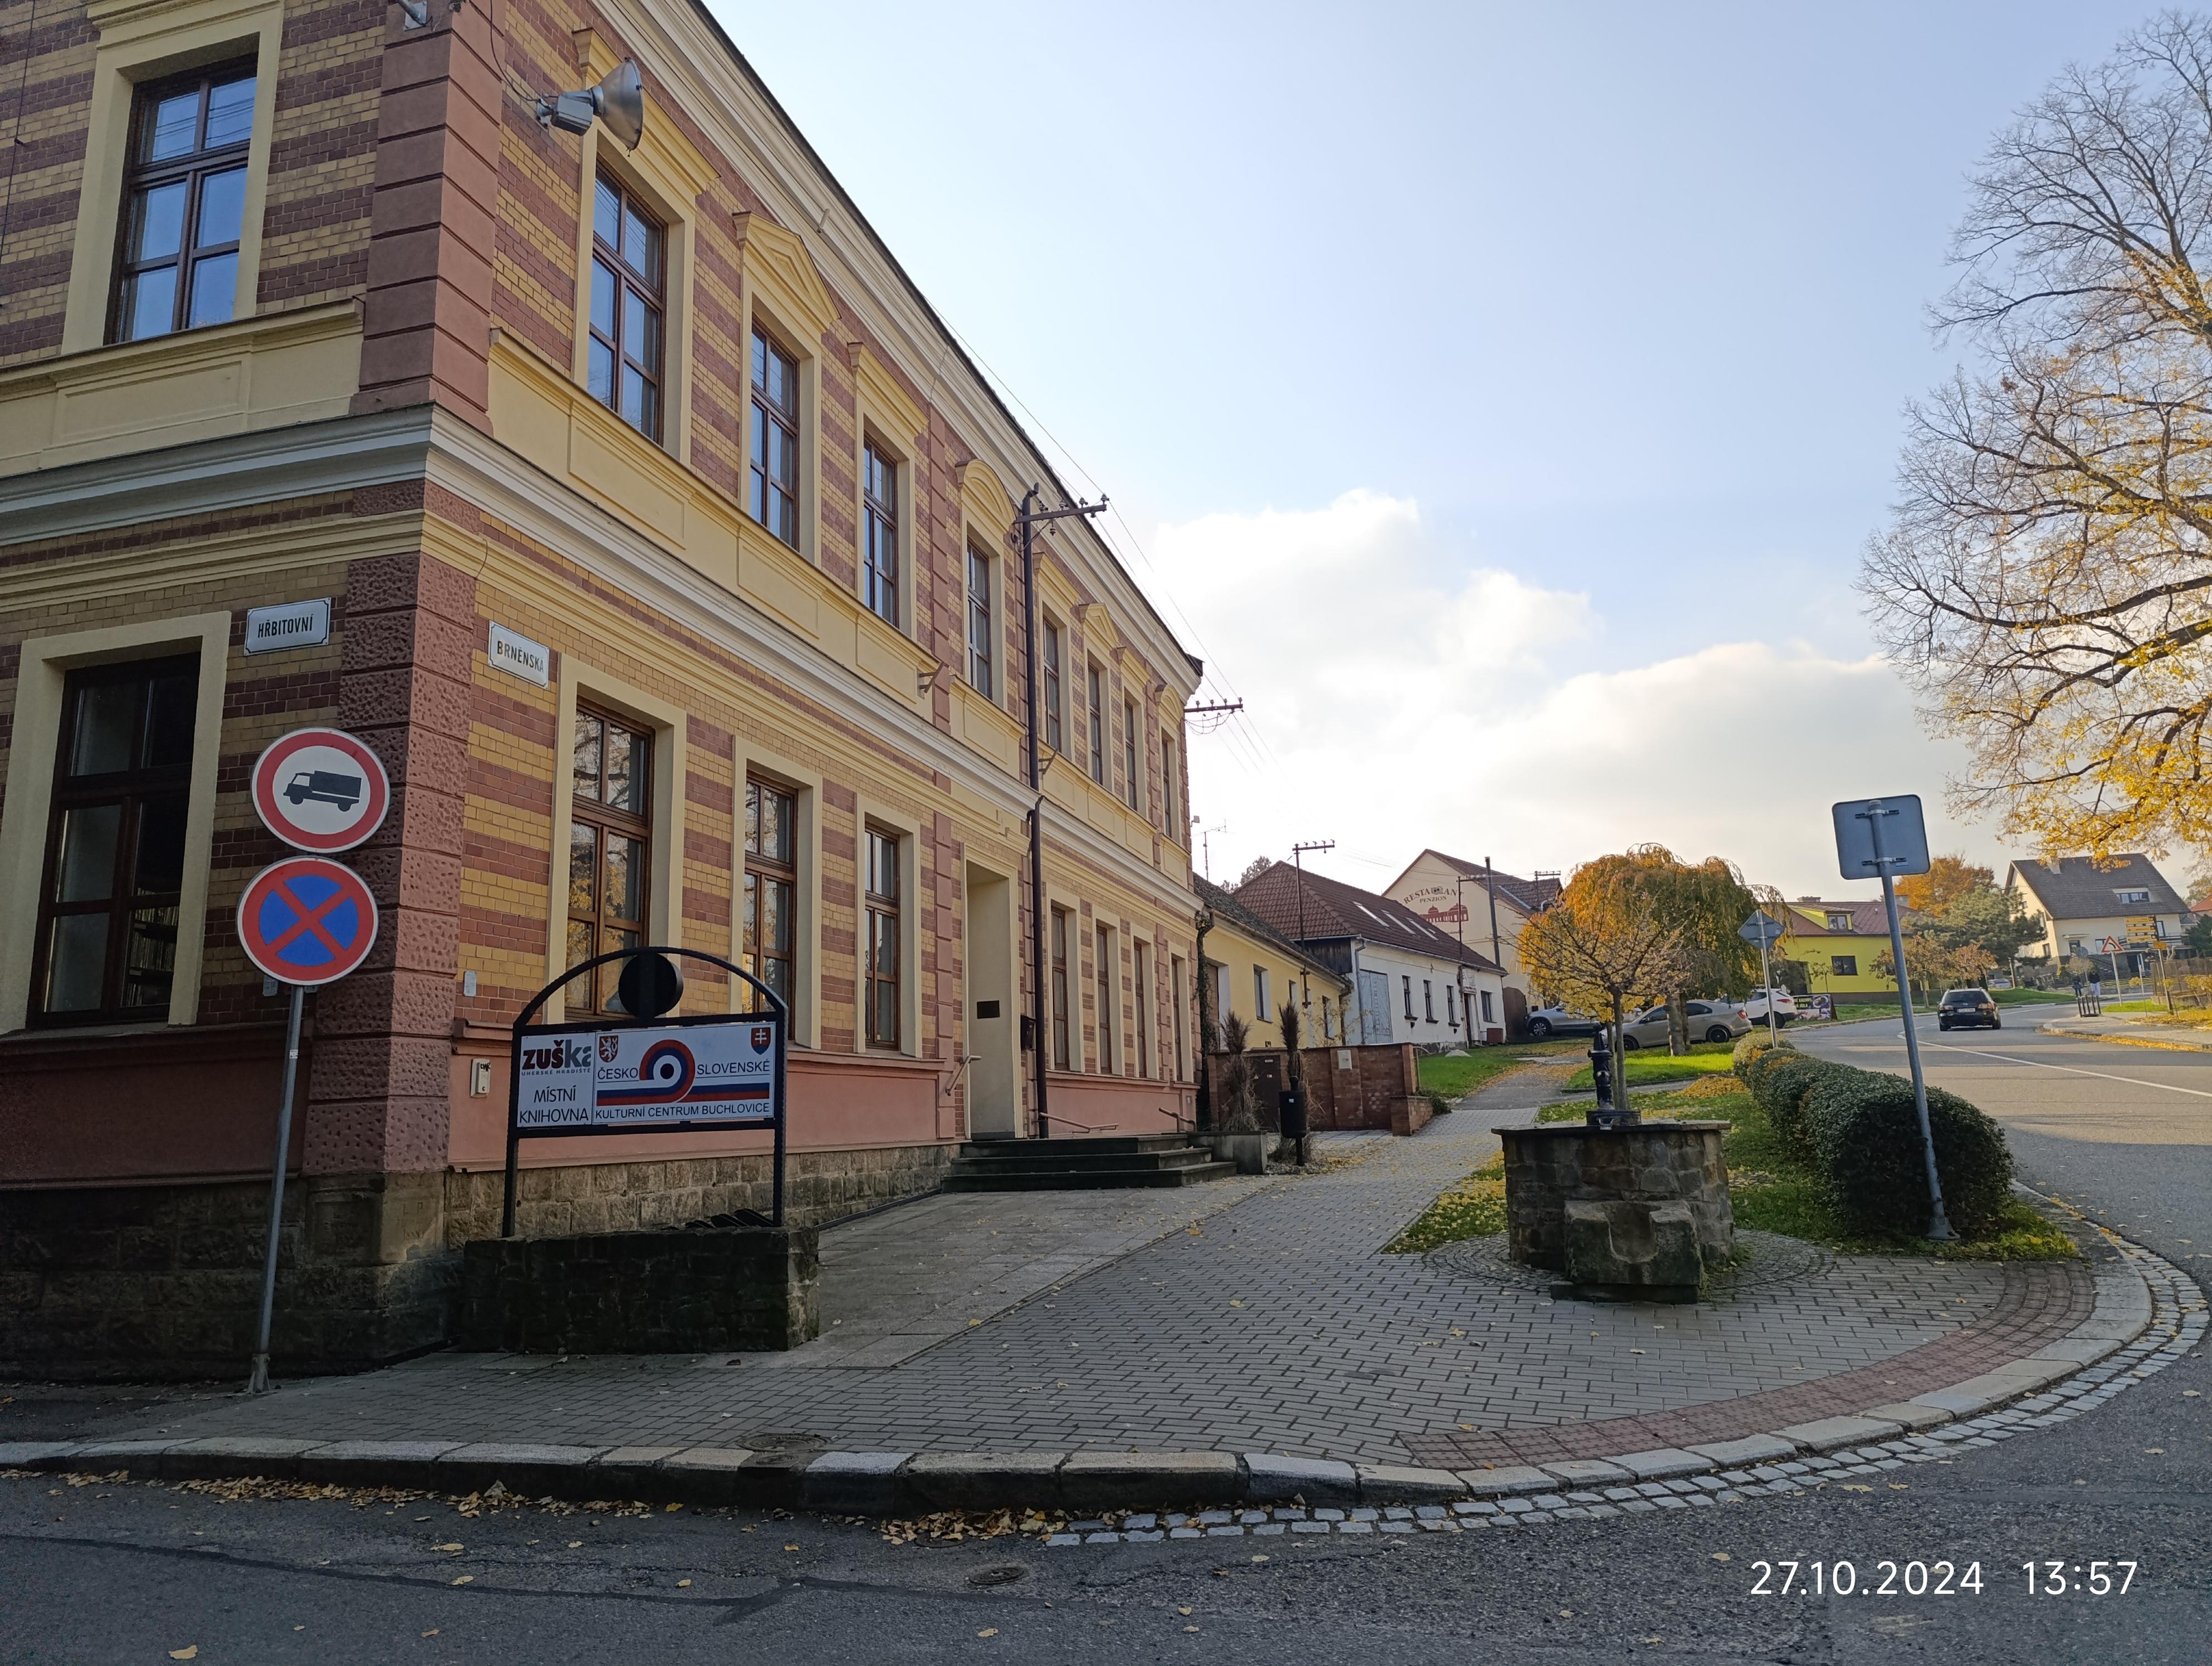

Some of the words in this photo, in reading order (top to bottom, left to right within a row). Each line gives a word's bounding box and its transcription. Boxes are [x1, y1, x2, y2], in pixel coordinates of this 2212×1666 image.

[258, 613, 314, 638] HŘBITOVNÍ
[497, 640, 544, 673] BRNĚNSKÁ
[597, 1067, 639, 1080] ČESKO
[697, 1058, 770, 1075] SLOVENSKÉ
[534, 1085, 576, 1103] MÍSTNÍ
[520, 1108, 589, 1123] KNIHOVNA
[596, 1106, 645, 1119] KULTURNÍ
[648, 1105, 698, 1117] CENTRUM
[702, 1103, 770, 1115] BUCHLOVICE
